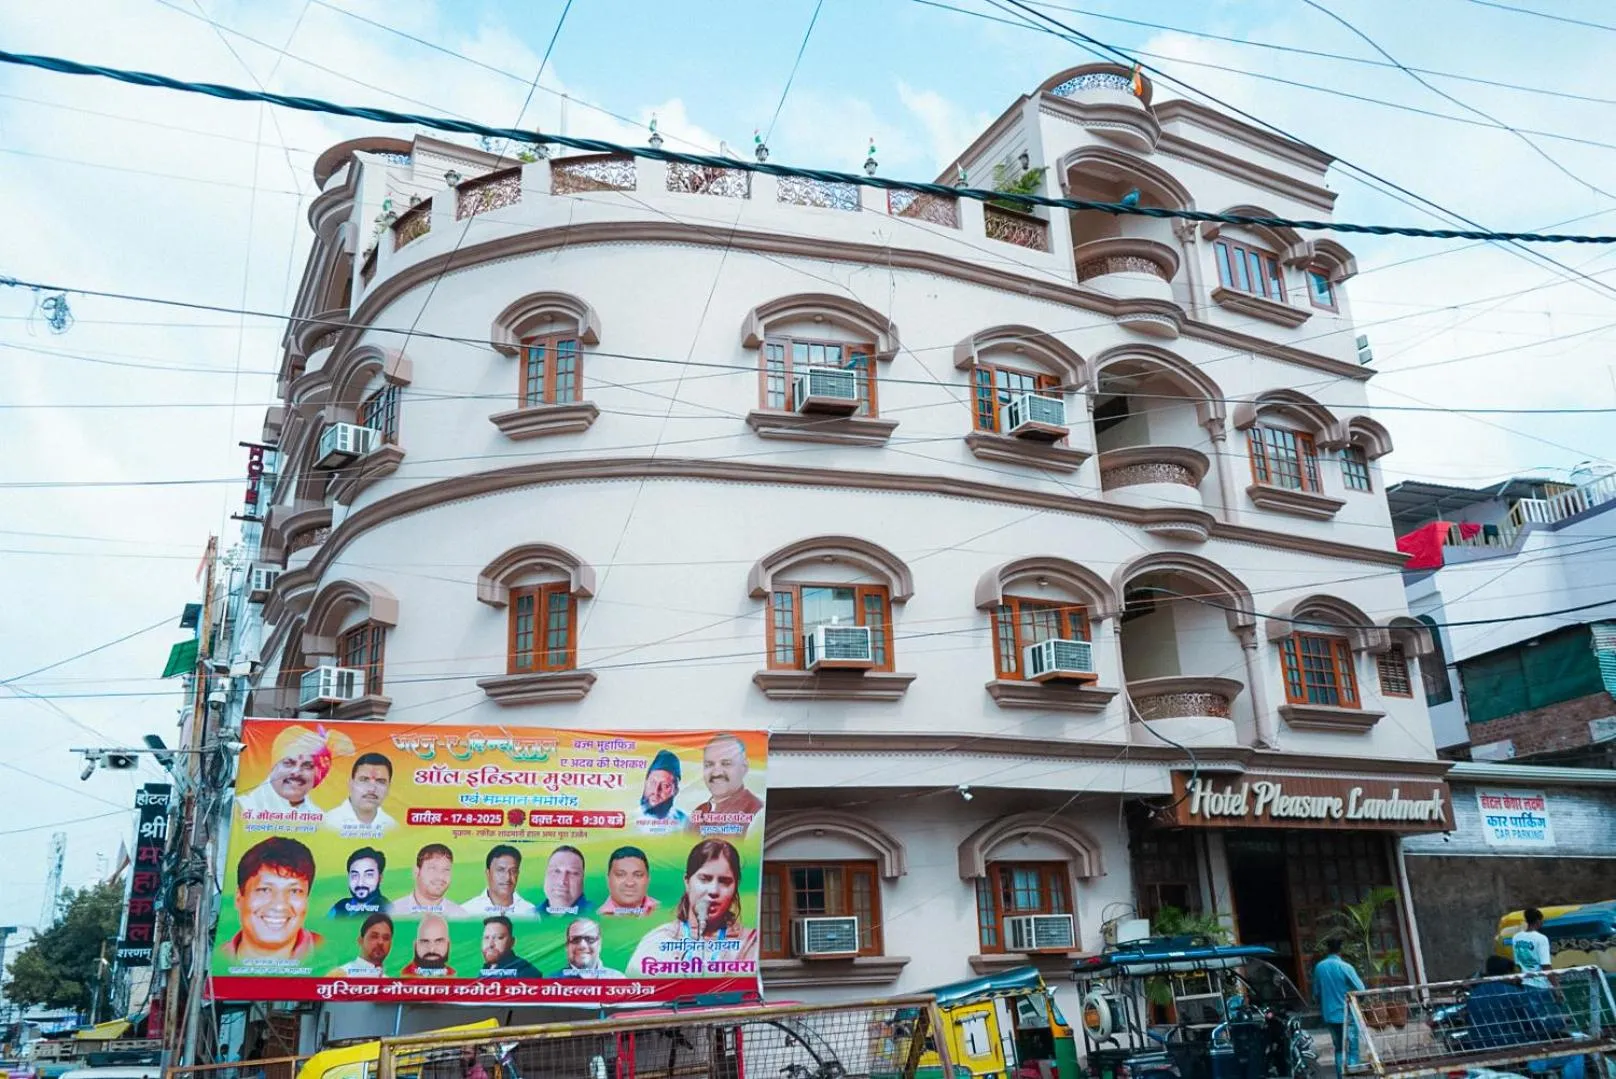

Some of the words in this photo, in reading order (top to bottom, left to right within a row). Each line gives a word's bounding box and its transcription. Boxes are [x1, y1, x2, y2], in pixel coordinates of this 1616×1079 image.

[597, 757, 610, 768] की
[415, 765, 459, 786] ऑल
[543, 771, 624, 791] मुशायरा
[136, 790, 169, 805] होटल
[1186, 778, 1249, 819] Hotel
[1252, 780, 1343, 818] Pleasure
[1345, 786, 1446, 822] Landmark
[257, 810, 283, 821] मोहन
[285, 810, 297, 820] जी
[451, 813, 502, 825] 17-8-2025
[582, 815, 605, 825] 9:30
[607, 812, 625, 826] बजे
[1486, 815, 1508, 827] कार
[140, 815, 167, 839] श्री
[641, 957, 702, 976] हिमांशी
[316, 982, 378, 998] मुस्लिम
[382, 981, 449, 996] नौजवान
[454, 981, 501, 996] कमेटी
[505, 982, 537, 996] कोट
[541, 982, 600, 997] मोहल्ला
[605, 983, 655, 996] उज्जैन
